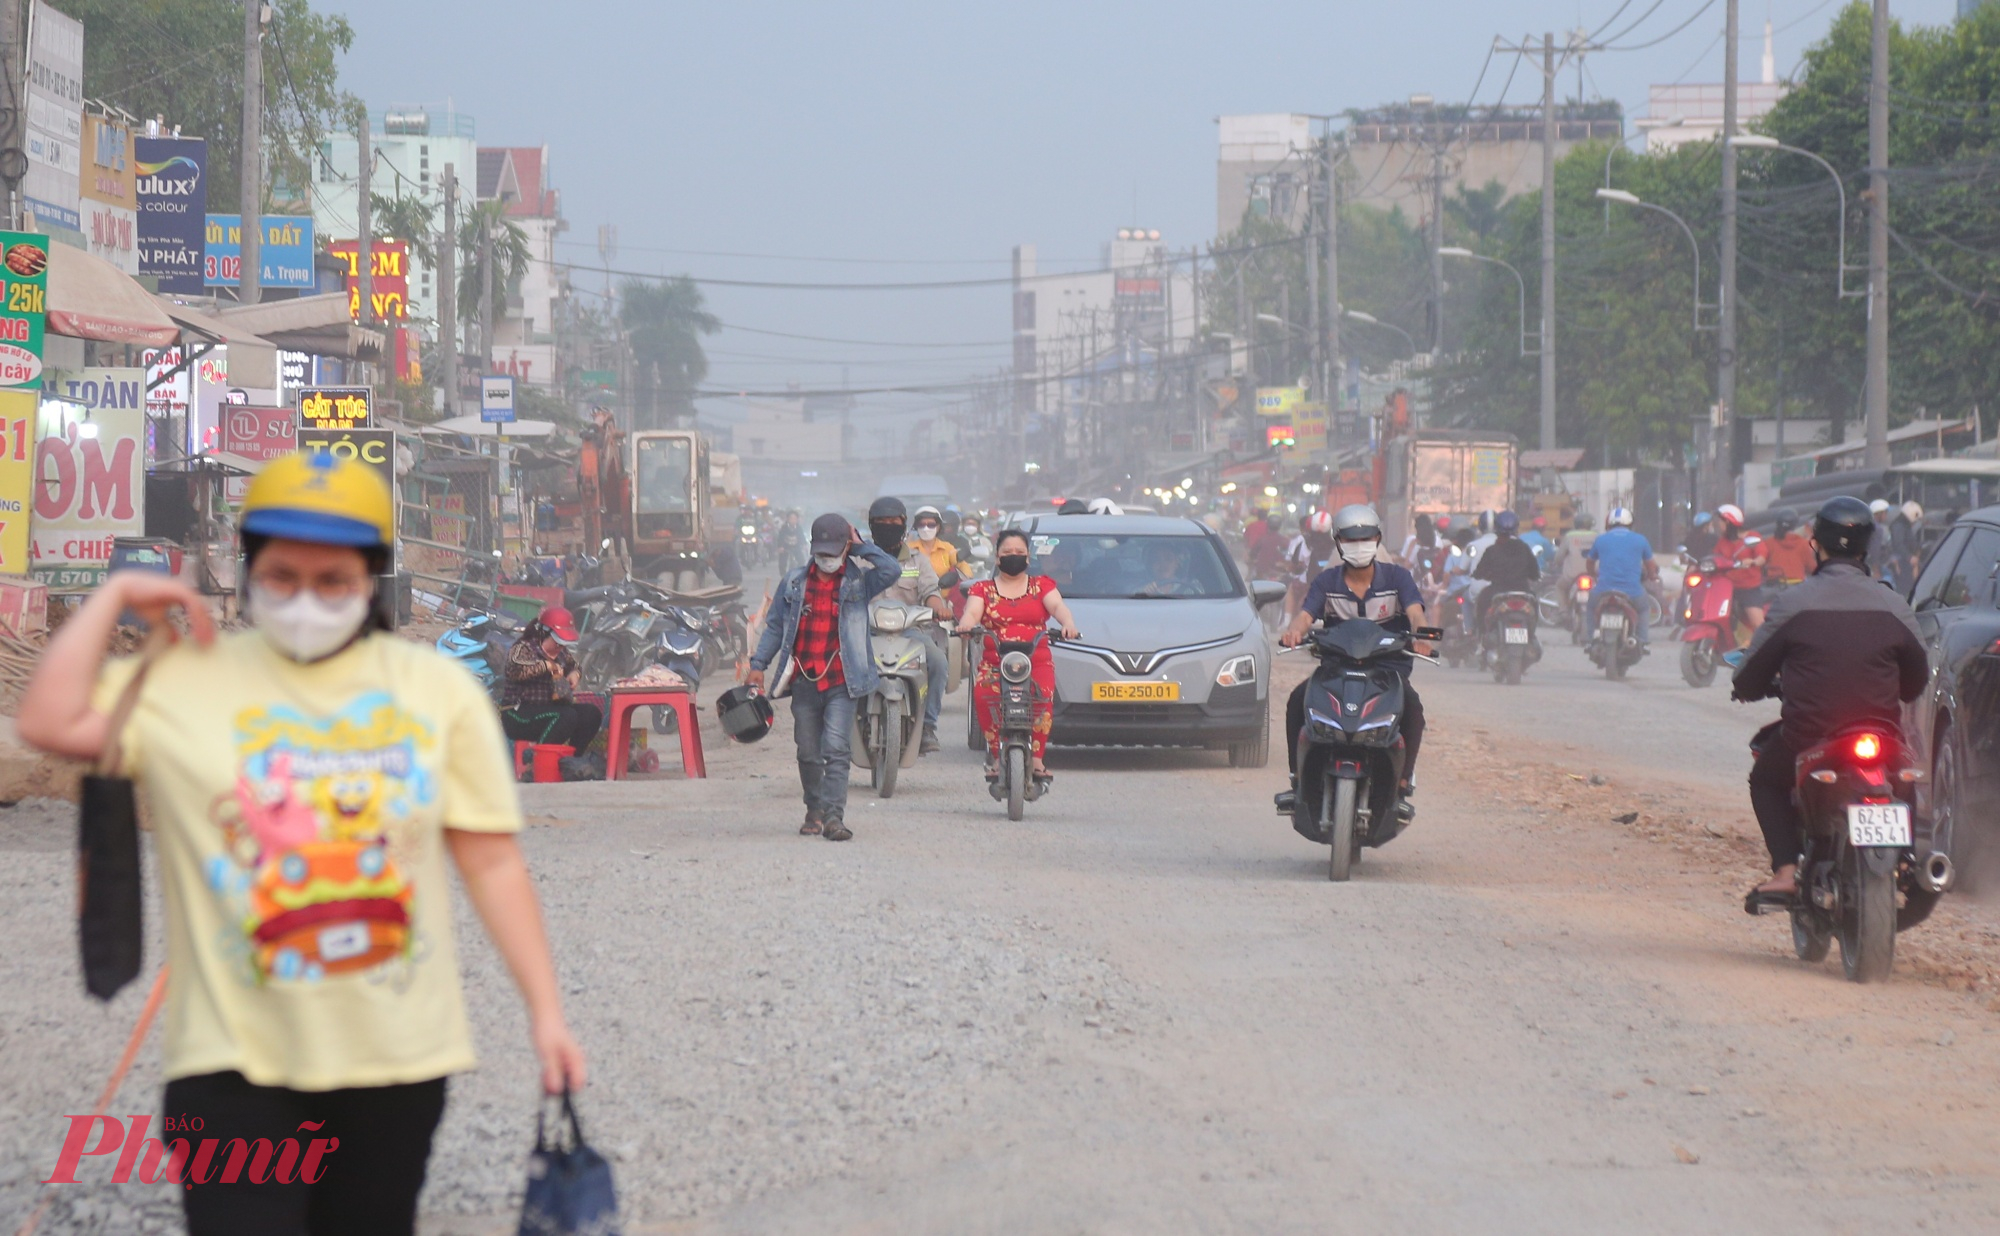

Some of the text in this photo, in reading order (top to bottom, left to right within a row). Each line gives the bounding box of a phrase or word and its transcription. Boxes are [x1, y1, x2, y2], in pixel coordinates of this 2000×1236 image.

[146, 201, 188, 213] colour
[269, 221, 302, 246] ĐẤT
[153, 246, 199, 265] PHÁT
[277, 265, 309, 284] Trọng
[8, 282, 45, 313] 25k
[5, 362, 32, 382] cây
[66, 375, 139, 410] TOÀN
[302, 391, 367, 419] CẮT TÓC
[305, 434, 387, 464] TÓC
[60, 571, 92, 584] 570
[1858, 808, 1900, 825] 62-E1
[1854, 826, 1907, 843] 355.41
